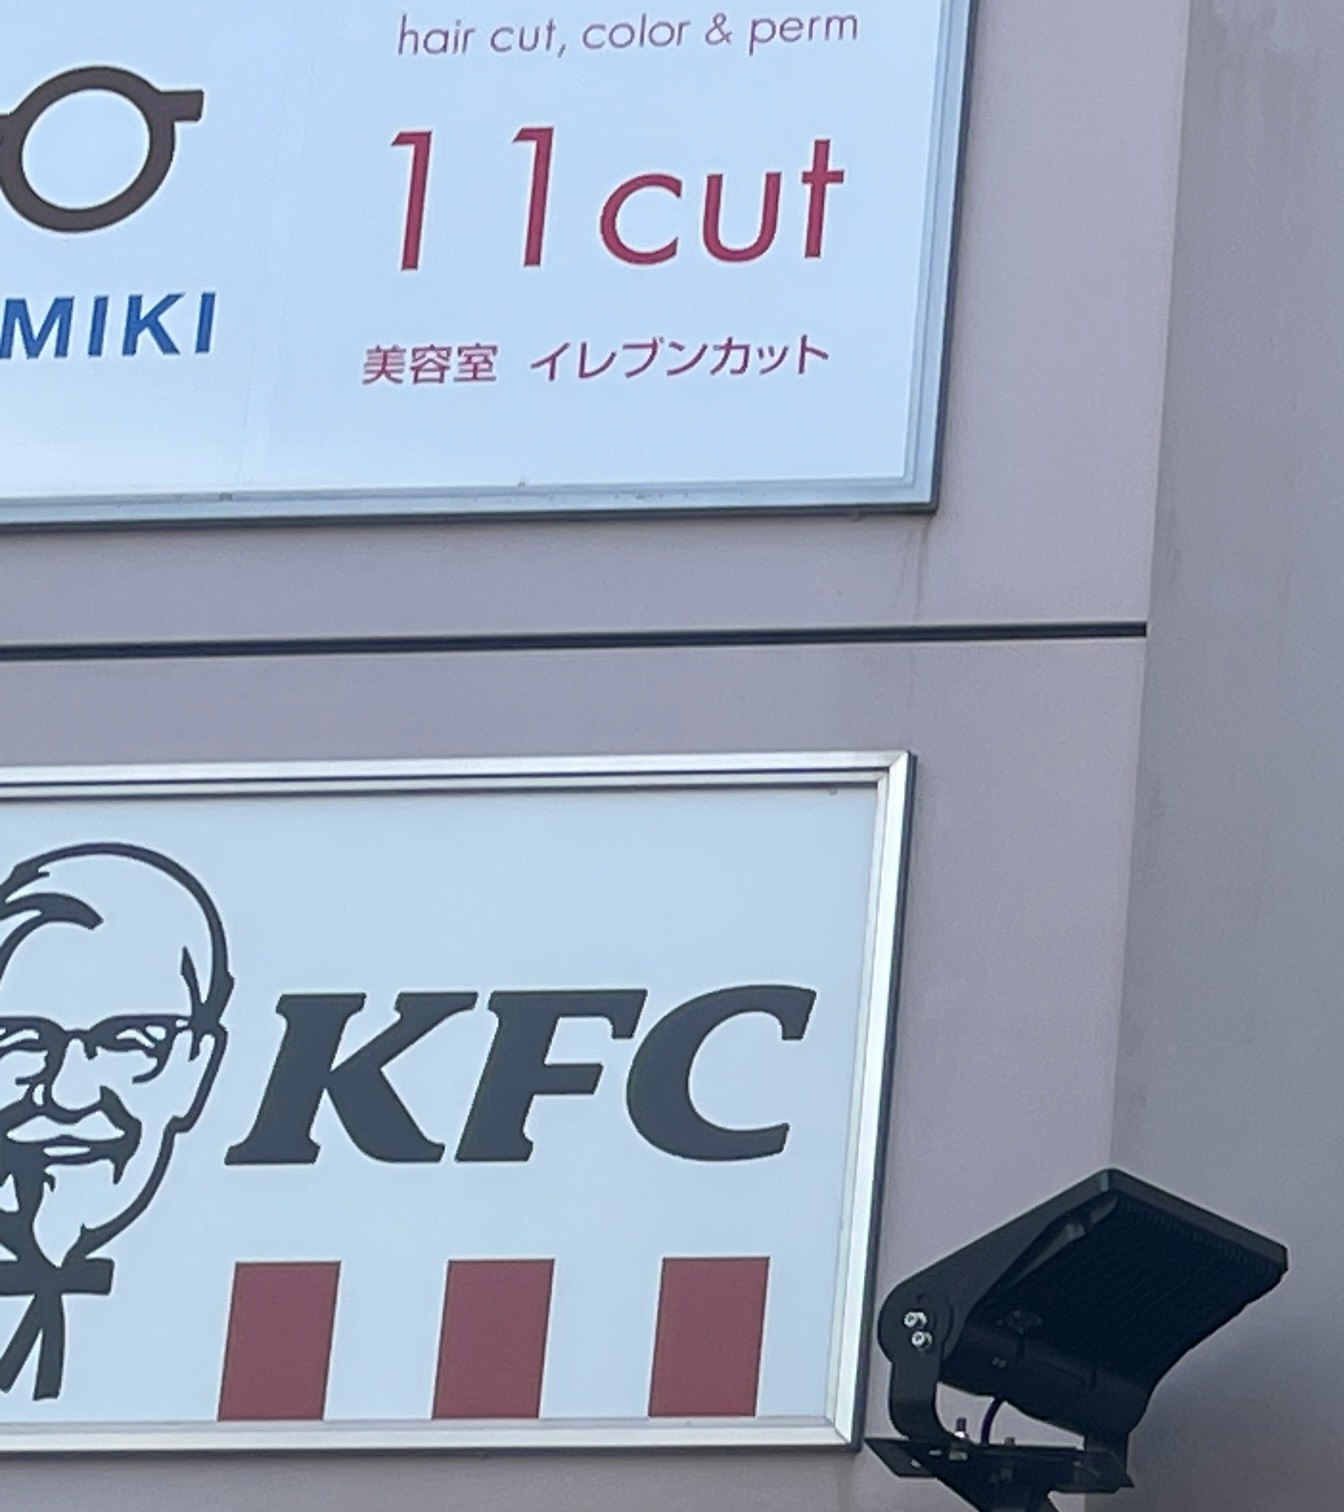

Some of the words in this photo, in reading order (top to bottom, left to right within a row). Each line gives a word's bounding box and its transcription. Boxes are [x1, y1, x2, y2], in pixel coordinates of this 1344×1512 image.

[398, 15, 475, 56] hair
[490, 20, 567, 58] cut,
[582, 13, 691, 50] color
[704, 12, 733, 45] &
[748, 14, 859, 56] perm
[0, 291, 217, 360] MIKI
[362, 343, 499, 386] 美容室
[529, 334, 830, 383] イレブンカット
[224, 984, 817, 1166] KFC
